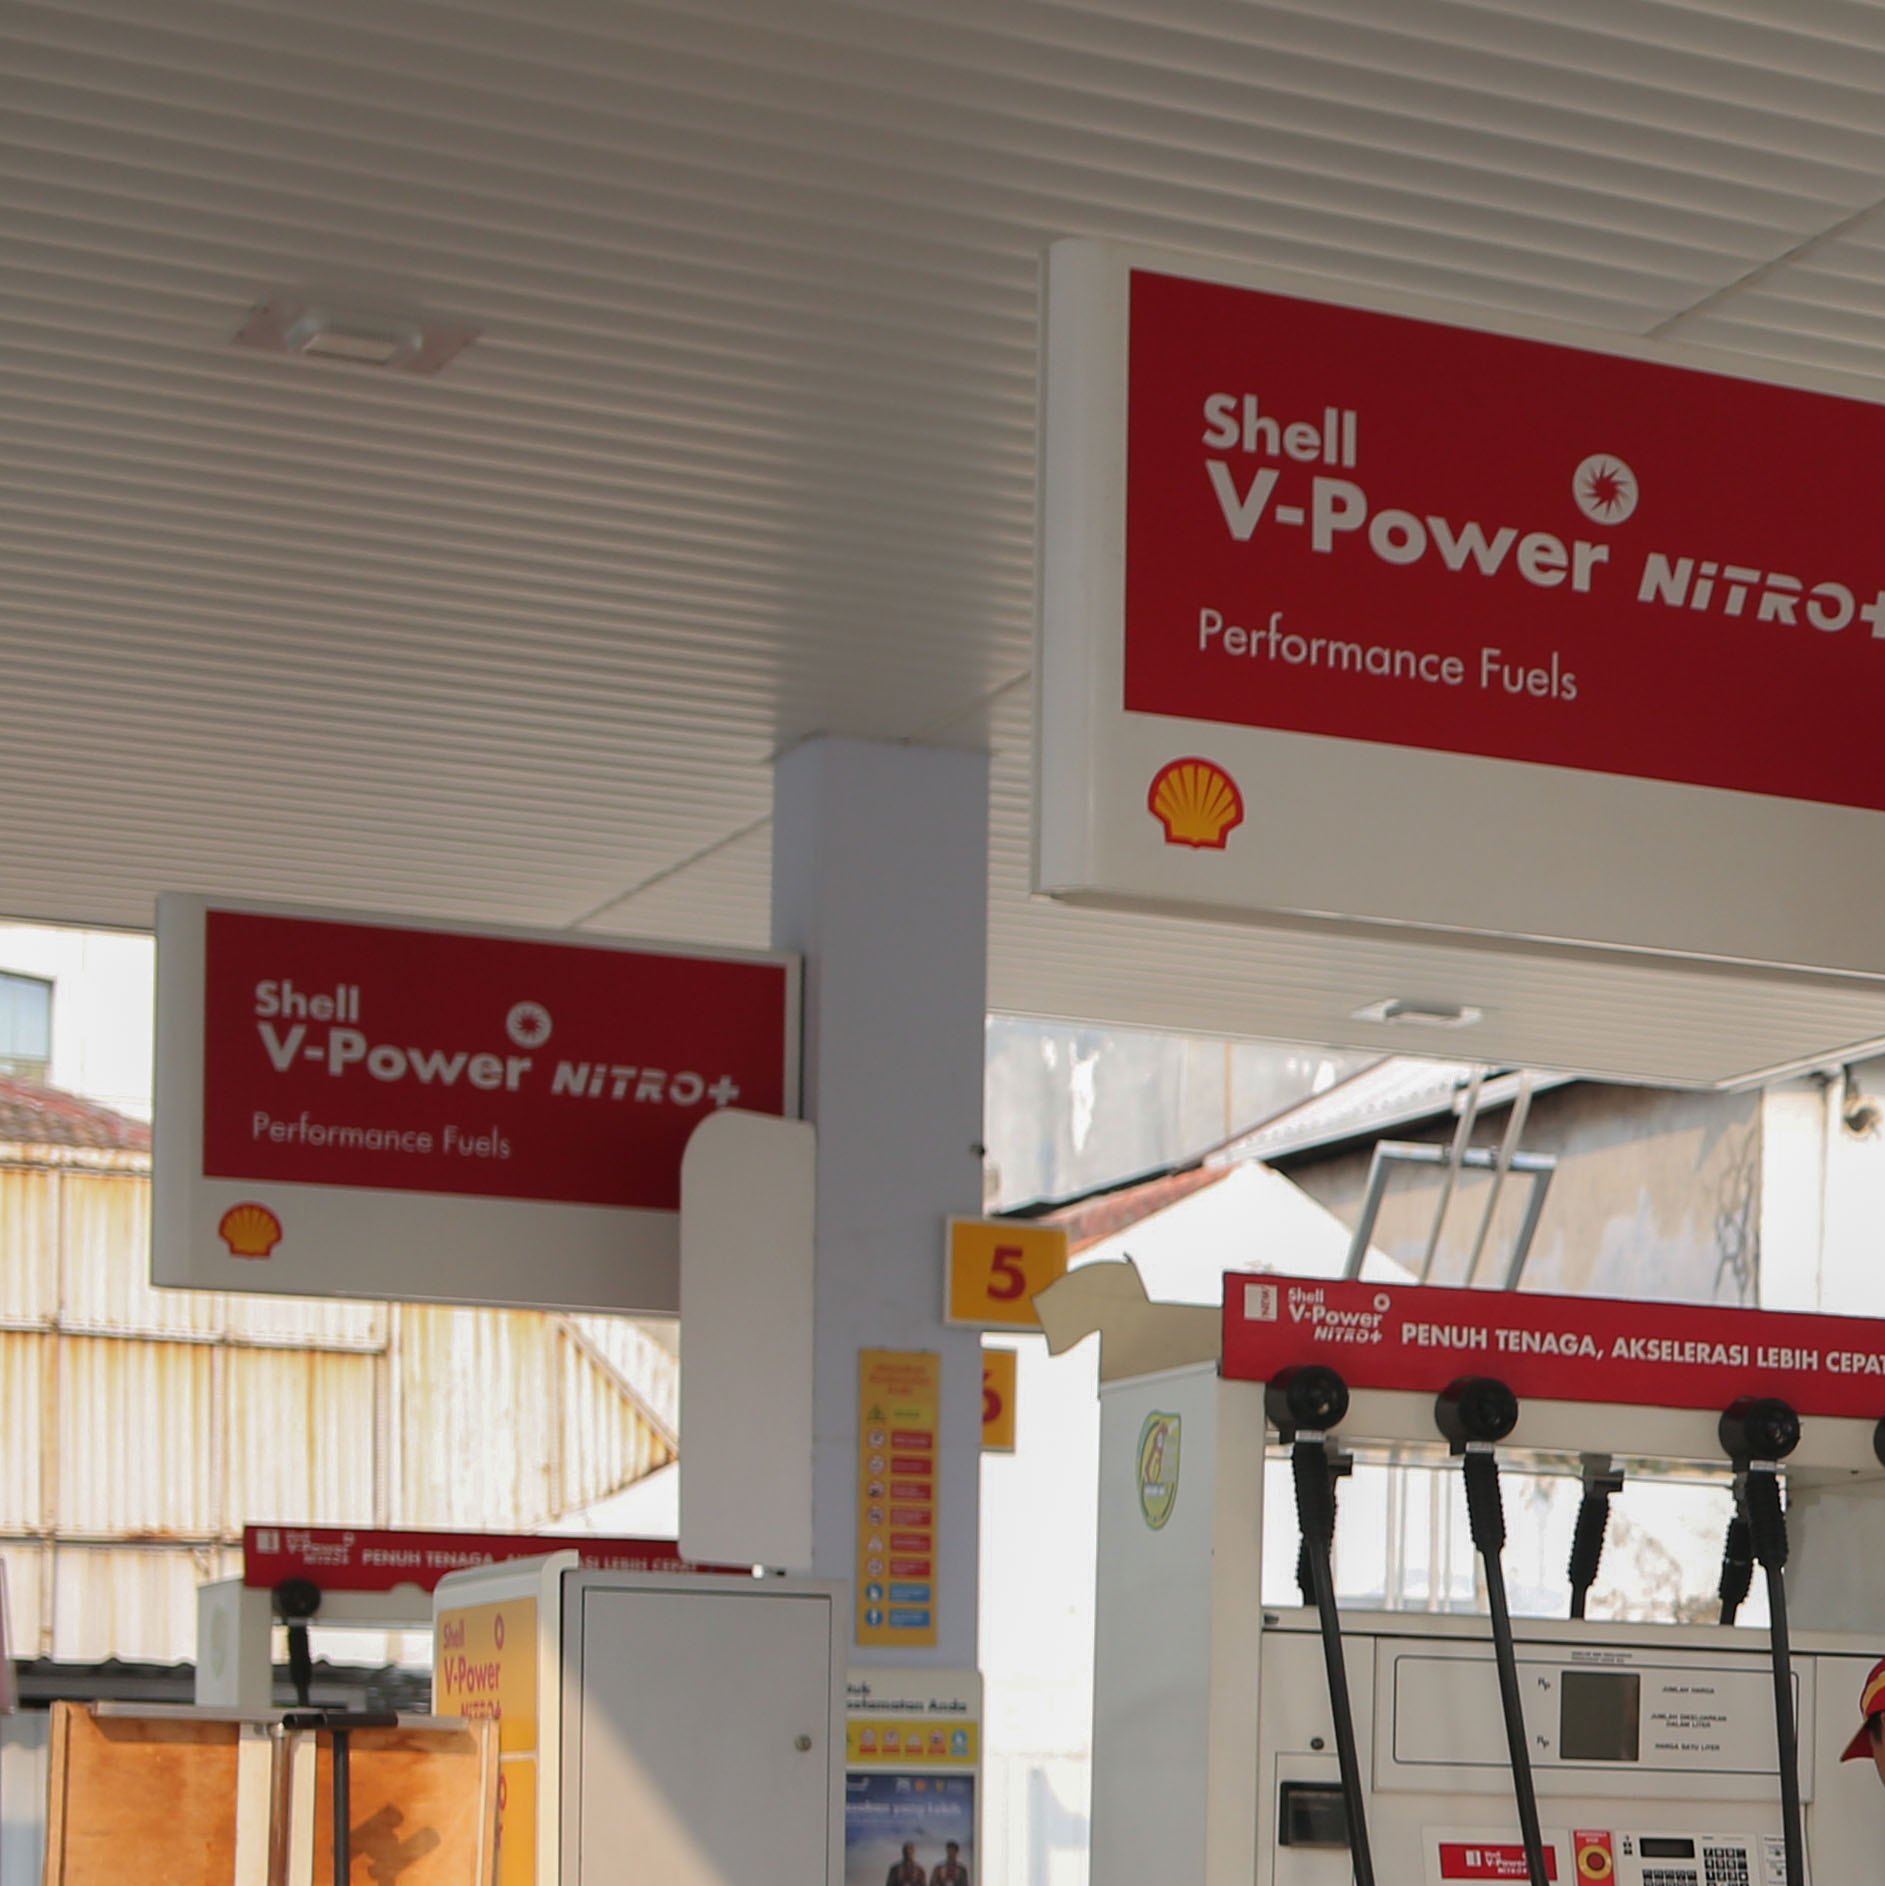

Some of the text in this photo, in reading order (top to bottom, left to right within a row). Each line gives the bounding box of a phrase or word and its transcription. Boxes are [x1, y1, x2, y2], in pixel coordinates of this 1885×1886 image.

[1203, 394, 1358, 467] Shell
[1205, 460, 1609, 591] V-Power
[1199, 609, 1578, 700] Performance Fuels
[255, 981, 358, 1023] Shell
[256, 1024, 533, 1091] V-Power
[253, 1112, 510, 1159] Performance Fuels
[986, 1248, 1026, 1303] 5
[1288, 1288, 1324, 1303] Shell
[1288, 1303, 1383, 1328] V-Power
[1401, 1322, 1488, 1351] PENUH
[1495, 1329, 1603, 1361] TENAGA,
[1611, 1336, 1749, 1368] AKSELERASI
[1756, 1345, 1818, 1371] LEBIH
[362, 1549, 422, 1566] PENUH
[444, 1619, 464, 1649] Shell
[444, 1656, 501, 1695] V-Power
